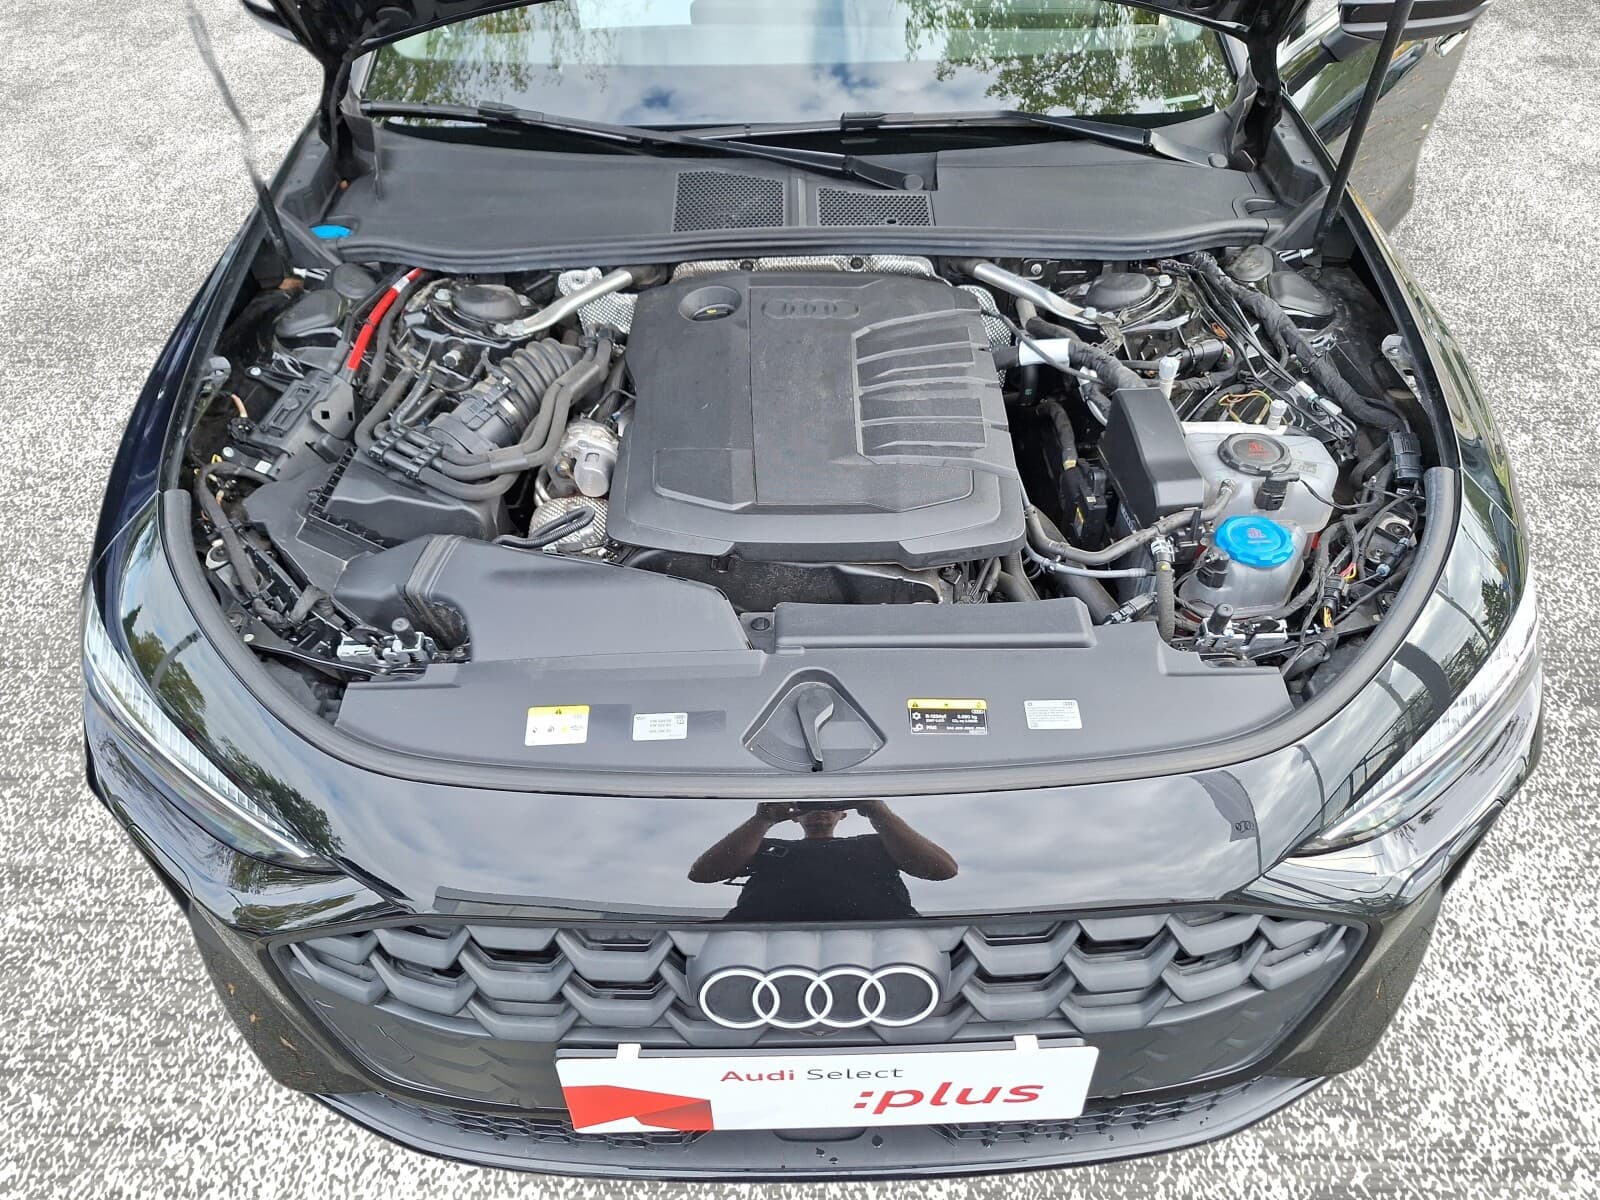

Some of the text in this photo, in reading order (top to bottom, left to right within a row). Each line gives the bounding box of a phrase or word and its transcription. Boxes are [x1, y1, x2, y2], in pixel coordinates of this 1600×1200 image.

[720, 1068, 904, 1082] Audi Select
[853, 1081, 1045, 1115] :plus
